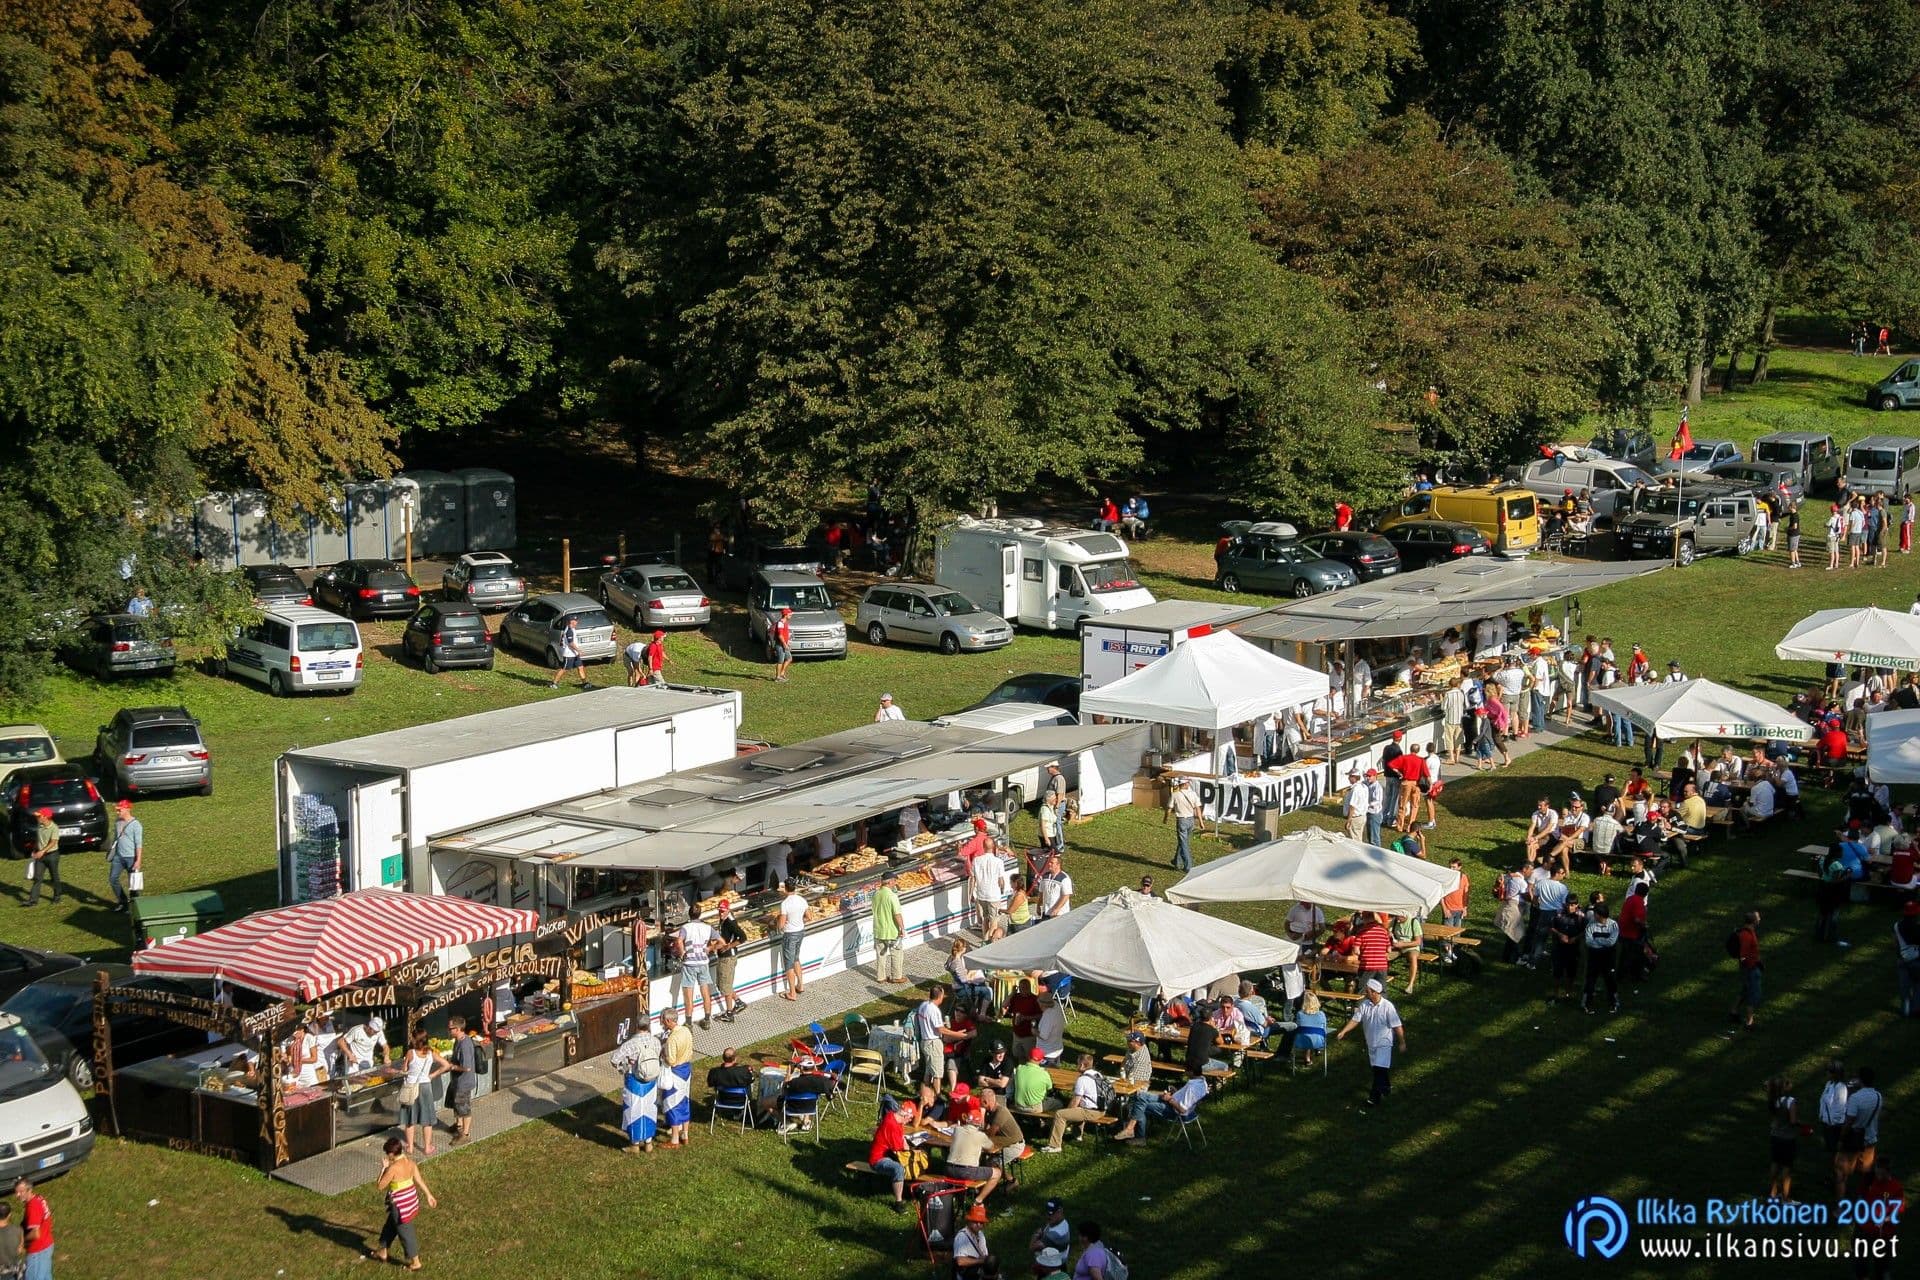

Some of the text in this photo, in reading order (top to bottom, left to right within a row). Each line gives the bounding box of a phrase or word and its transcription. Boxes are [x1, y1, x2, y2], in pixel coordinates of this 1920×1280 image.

[1130, 644, 1162, 655] RENT
[1849, 651, 1916, 668] Heineken
[1733, 724, 1803, 739] Heineken
[1199, 770, 1319, 822] PIADINERIA
[536, 920, 567, 938] Chicken
[394, 960, 439, 985] HOT DOG
[423, 942, 537, 992] SALSICCIA
[421, 982, 474, 1017] SALSICCIA
[495, 956, 562, 981] BROCCOLETTI
[244, 1002, 287, 1026] PATATINE
[302, 985, 396, 1023] SALSICCIA
[252, 1011, 285, 1035] FRITTE
[272, 1046, 290, 1167] ROMAGNA
